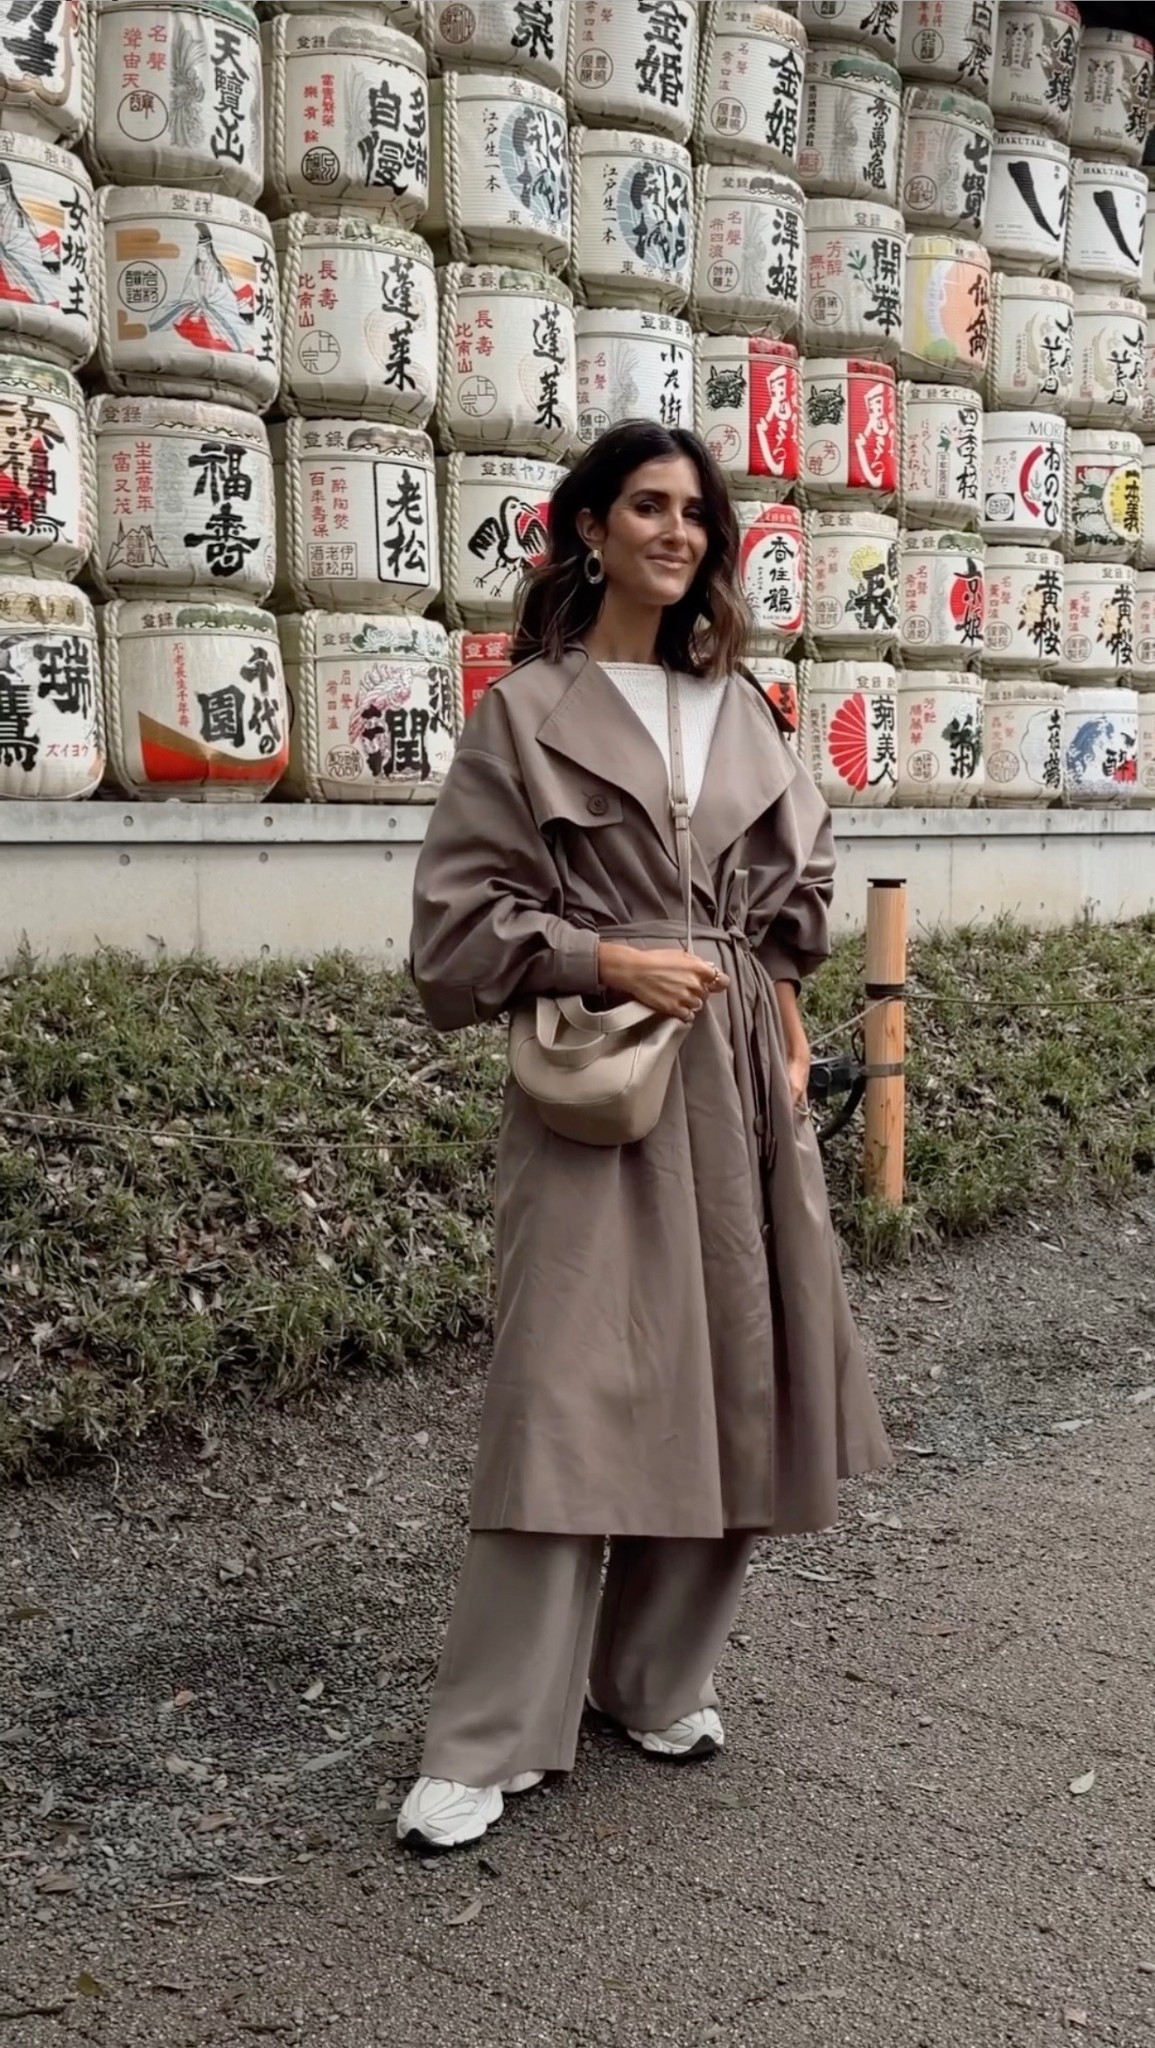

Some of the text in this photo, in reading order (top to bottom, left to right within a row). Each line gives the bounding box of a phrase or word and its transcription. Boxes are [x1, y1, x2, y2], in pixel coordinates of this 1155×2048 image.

[482, 107, 502, 193] 江戸生一本
[601, 164, 619, 245] 江戸生一本
[60, 186, 89, 321] 女城主
[766, 208, 799, 304] 澤姫
[253, 243, 276, 366] 女城主
[326, 546, 339, 576] 老松
[341, 546, 354, 576] 伊丹
[383, 469, 427, 578] 老松
[763, 536, 795, 613] 香住鶴
[46, 744, 88, 757] ズイヨウ
[868, 694, 898, 788] 菊美人
